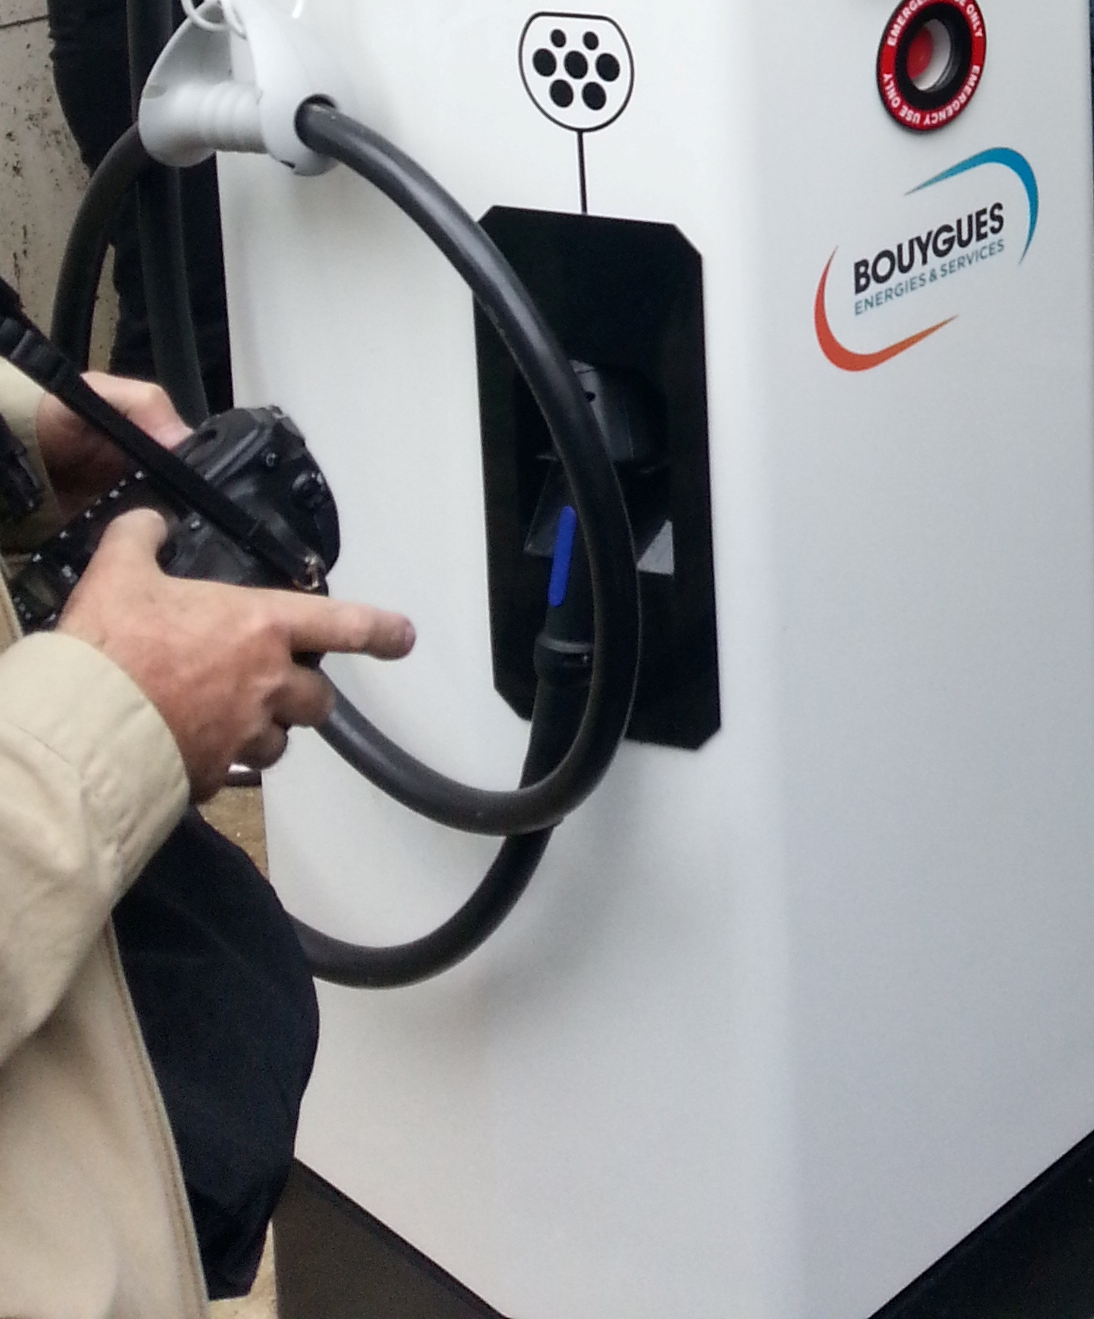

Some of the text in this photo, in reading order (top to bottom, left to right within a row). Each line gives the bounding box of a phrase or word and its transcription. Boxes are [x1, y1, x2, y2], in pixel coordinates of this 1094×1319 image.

[966, 1, 984, 38] ONLY
[883, 64, 980, 127] EMERGENCY USE ONLY
[853, 201, 1005, 295] BOUYGUES
[854, 238, 1005, 316] ENERGIES & SERVICES
